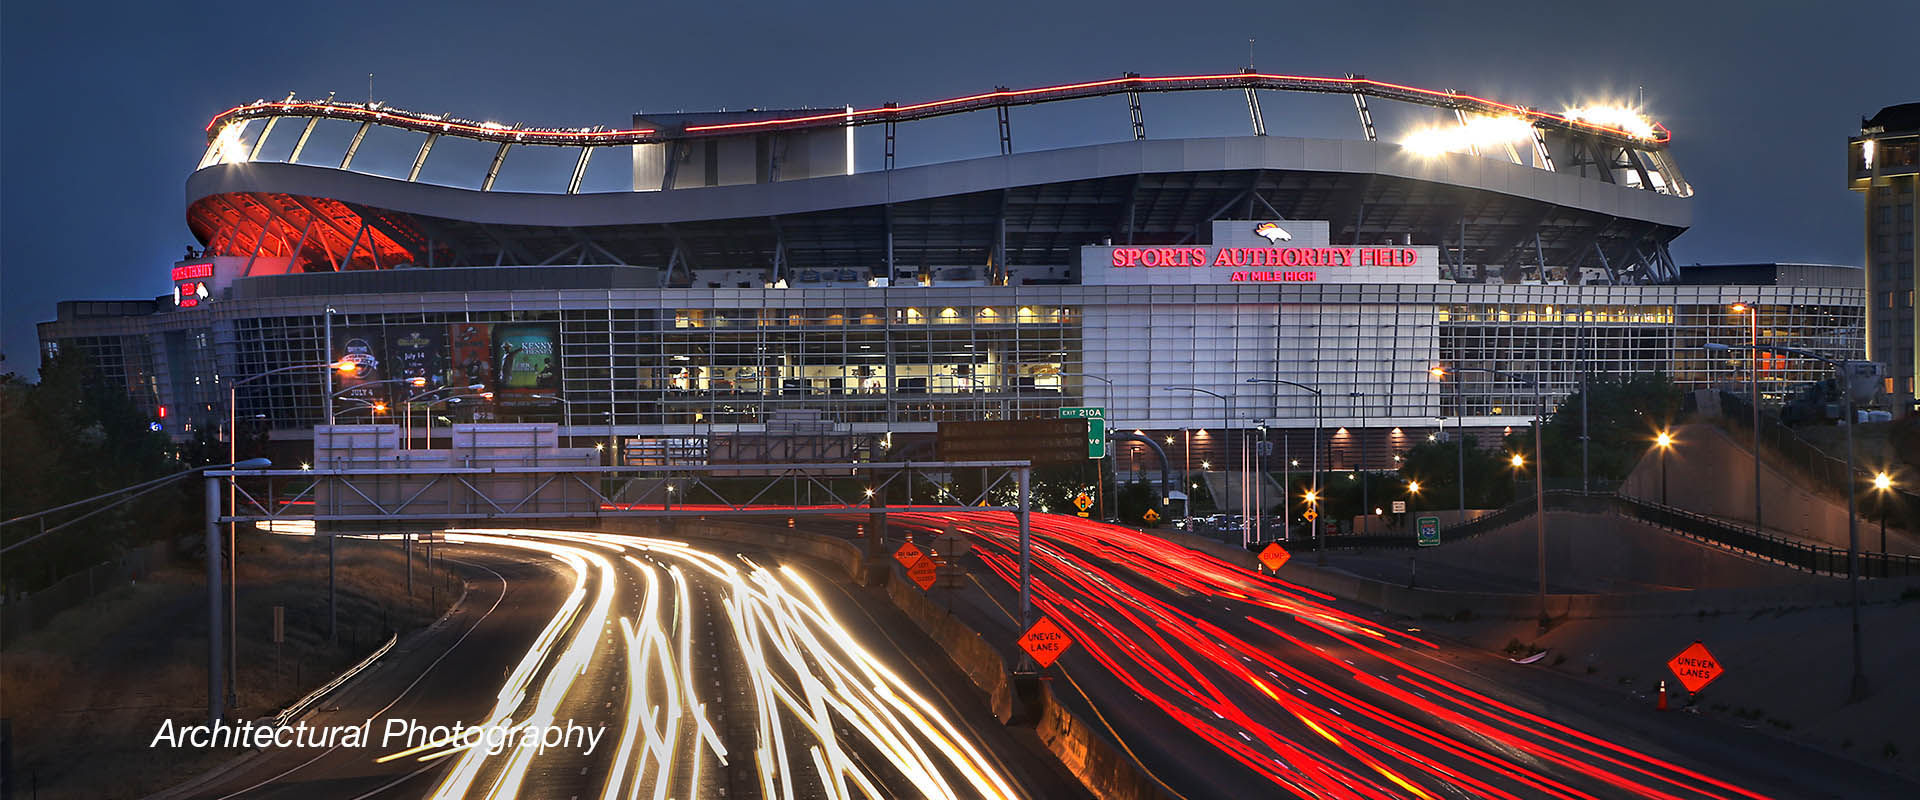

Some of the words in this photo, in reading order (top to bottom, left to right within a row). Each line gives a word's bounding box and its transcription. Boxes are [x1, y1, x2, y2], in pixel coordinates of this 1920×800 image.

[1112, 247, 1206, 268] SPORTS
[1213, 247, 1355, 267] AUTHORITY
[1360, 248, 1418, 267] FIELD
[1231, 271, 1249, 281] AT
[1252, 271, 1282, 281] MILE
[1285, 271, 1317, 281] HIGH
[404, 352, 416, 360] July
[1263, 552, 1286, 560] BUMP
[1027, 632, 1061, 641] UNEVEN
[1030, 642, 1059, 652] LANES
[1678, 657, 1714, 668] UNEVEN
[1680, 668, 1710, 679] LANES
